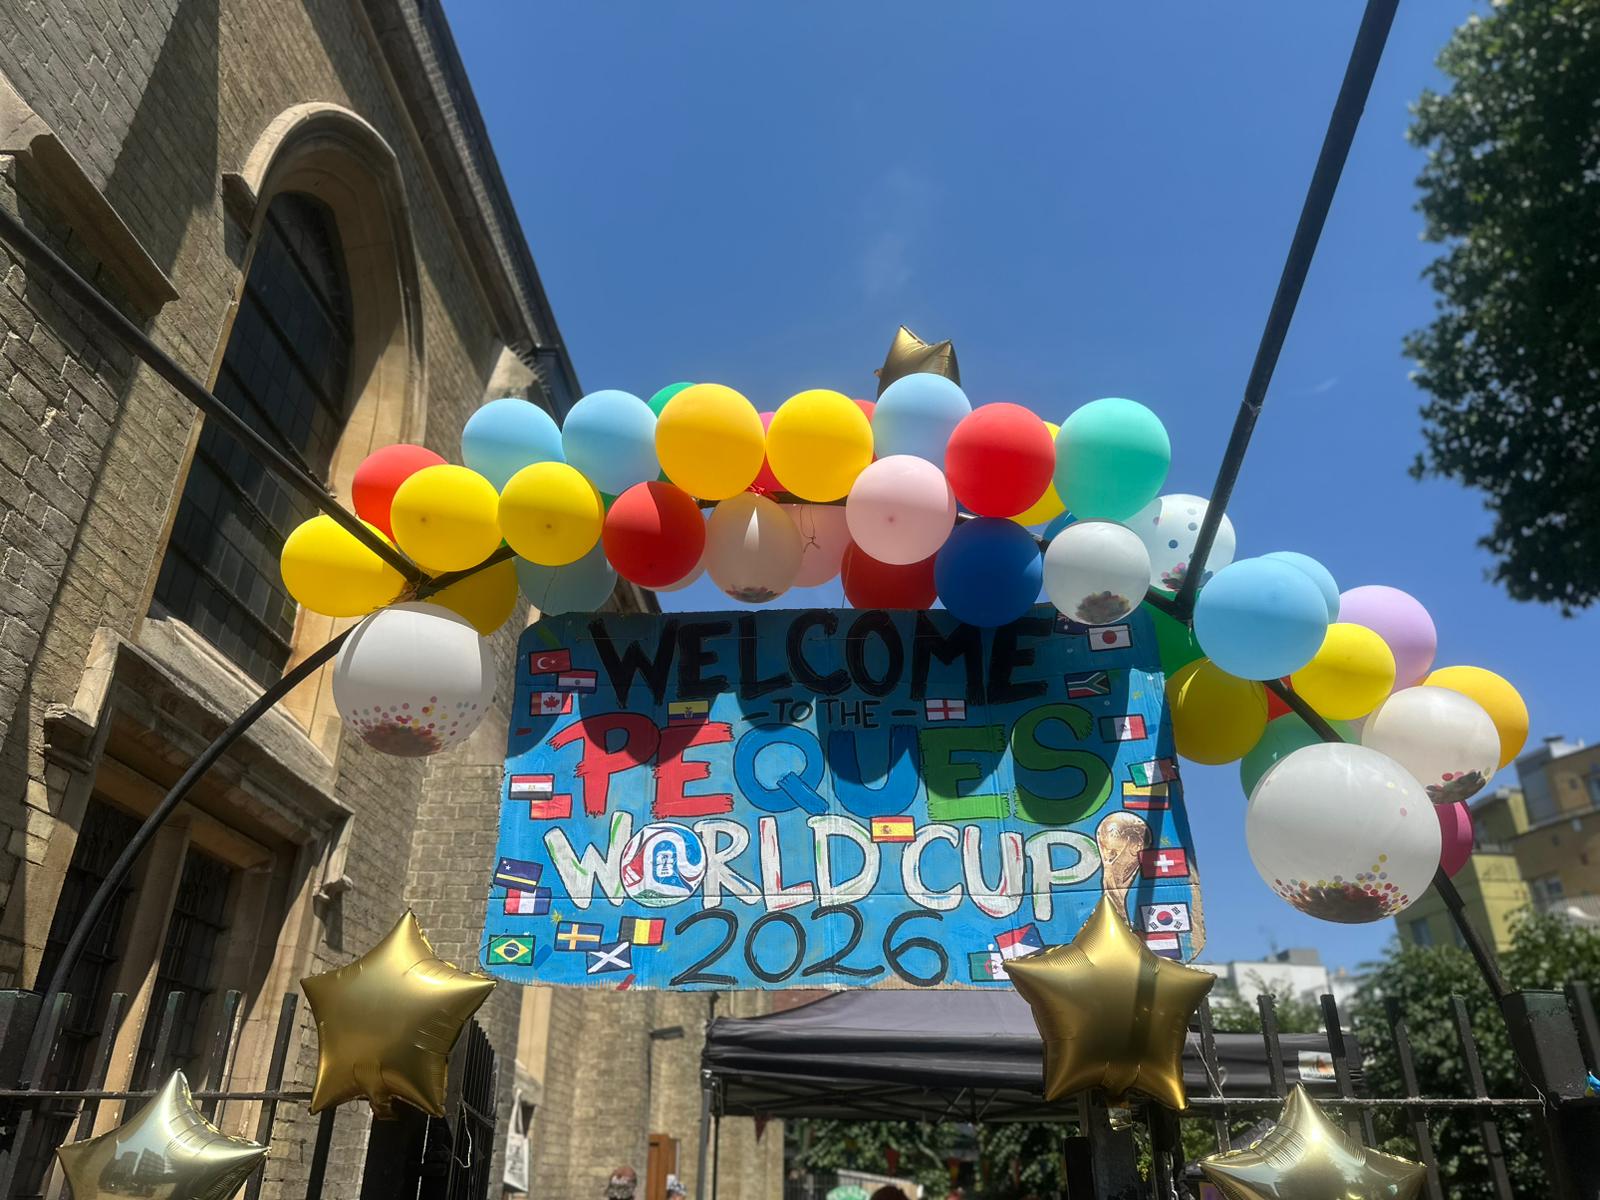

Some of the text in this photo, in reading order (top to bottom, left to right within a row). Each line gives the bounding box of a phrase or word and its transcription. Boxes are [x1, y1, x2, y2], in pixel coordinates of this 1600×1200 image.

[588, 608, 1050, 709] WELCOME
[772, 698, 814, 723] TO
[817, 699, 882, 729] THE
[546, 703, 1113, 825] PEQUES
[902, 824, 1101, 922] CUP
[669, 905, 949, 987] 2026
